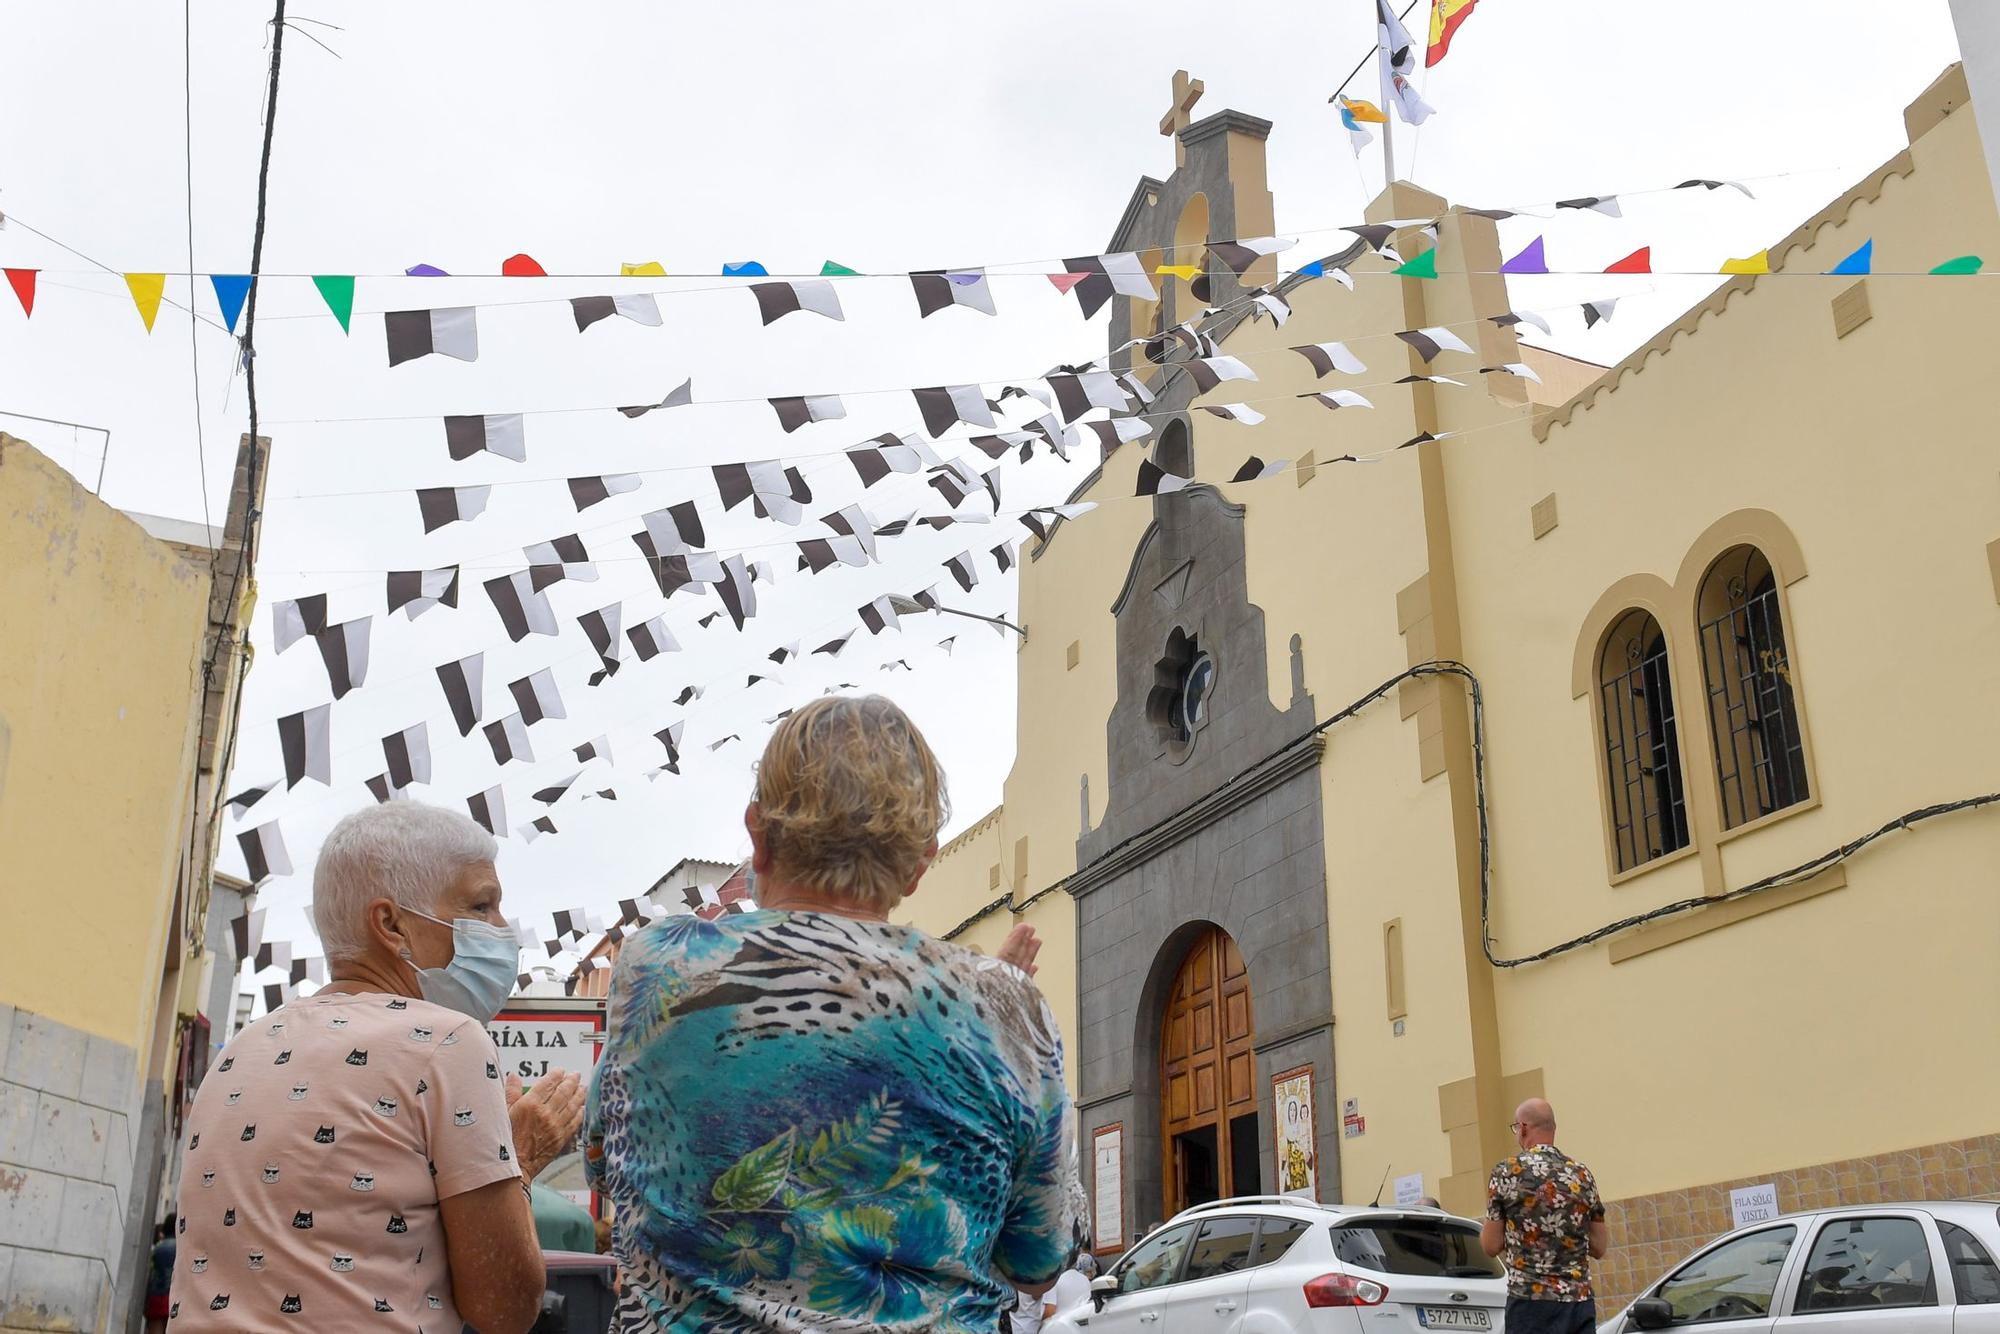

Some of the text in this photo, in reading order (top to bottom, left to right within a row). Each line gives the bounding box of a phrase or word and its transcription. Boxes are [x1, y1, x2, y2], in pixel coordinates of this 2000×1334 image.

[535, 1030, 568, 1048] LA
[1734, 1192, 1773, 1208] FILA SÓLO
[1741, 1208, 1769, 1222] VISITA
[1426, 1309, 1488, 1326] 5727 HJB
